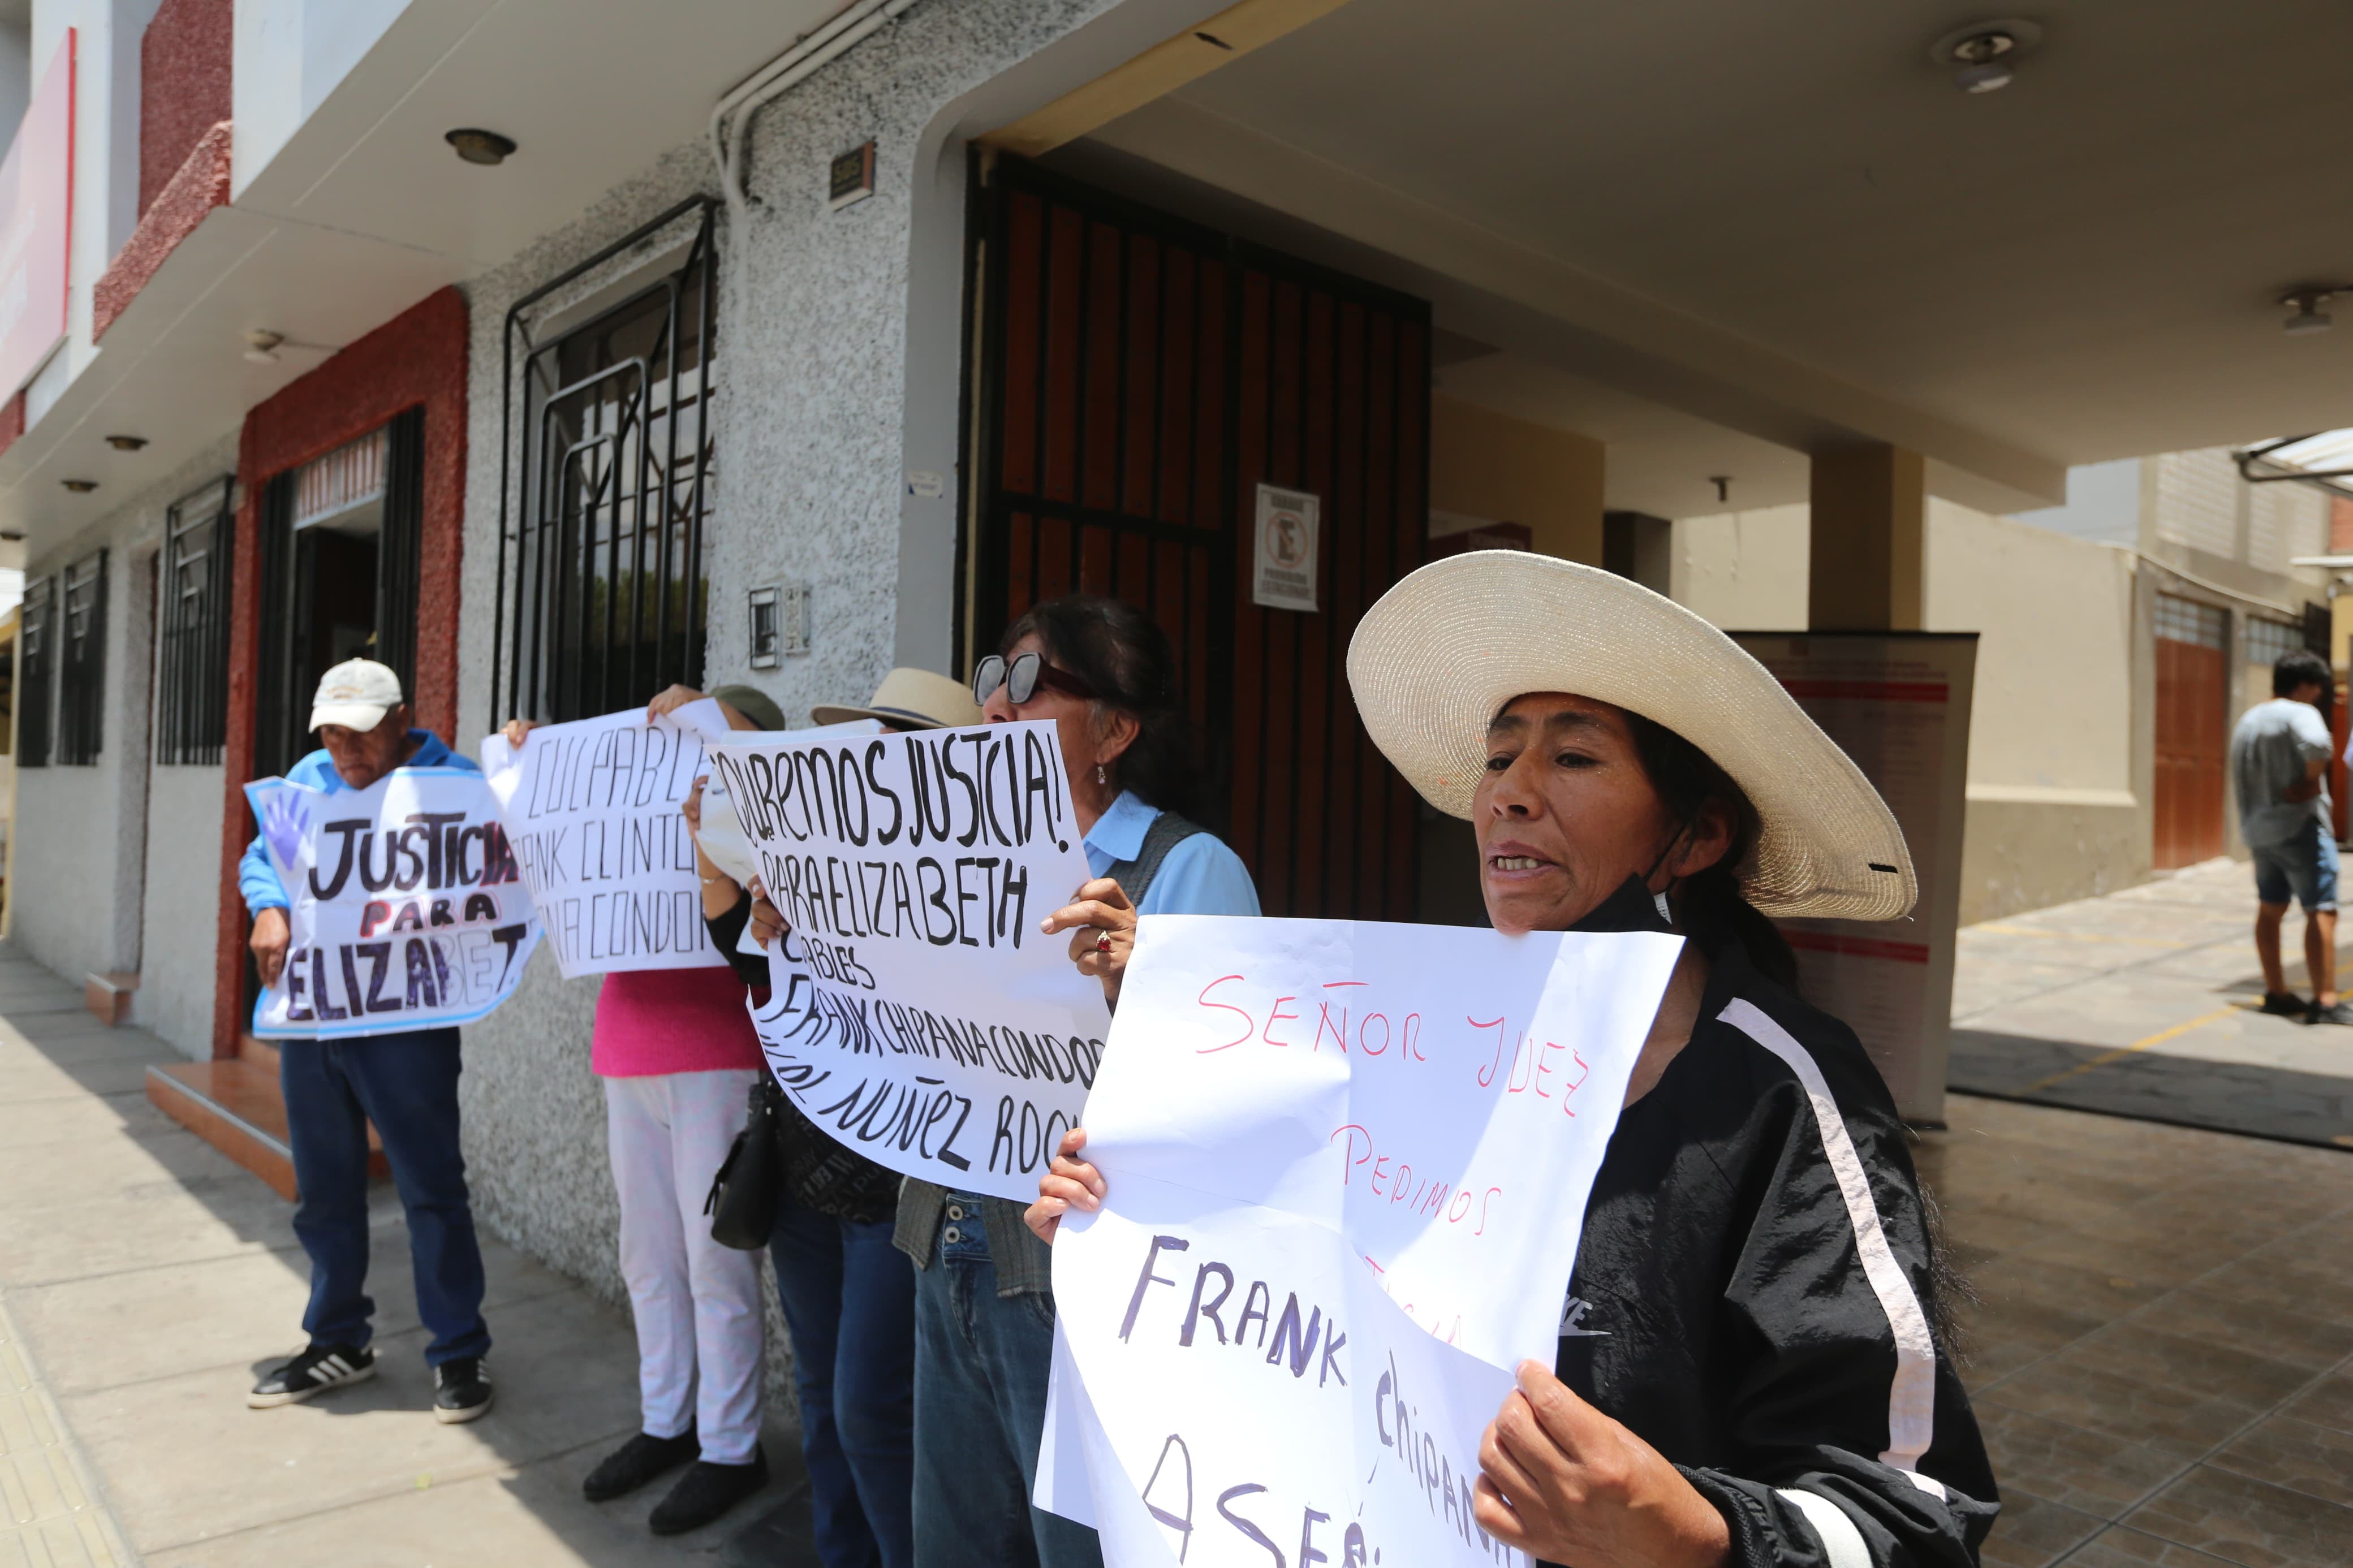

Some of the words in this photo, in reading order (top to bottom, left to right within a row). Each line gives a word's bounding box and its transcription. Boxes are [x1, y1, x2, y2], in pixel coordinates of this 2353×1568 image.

[360, 892, 502, 938] PARA
[828, 857, 1028, 949] ELIZABETH
[1195, 975, 1426, 1062] SEÑOR
[1467, 1016, 1589, 1118] JUEZ
[1330, 1124, 1502, 1236] PEDIMOS
[1118, 1234, 1348, 1389] FRANK
